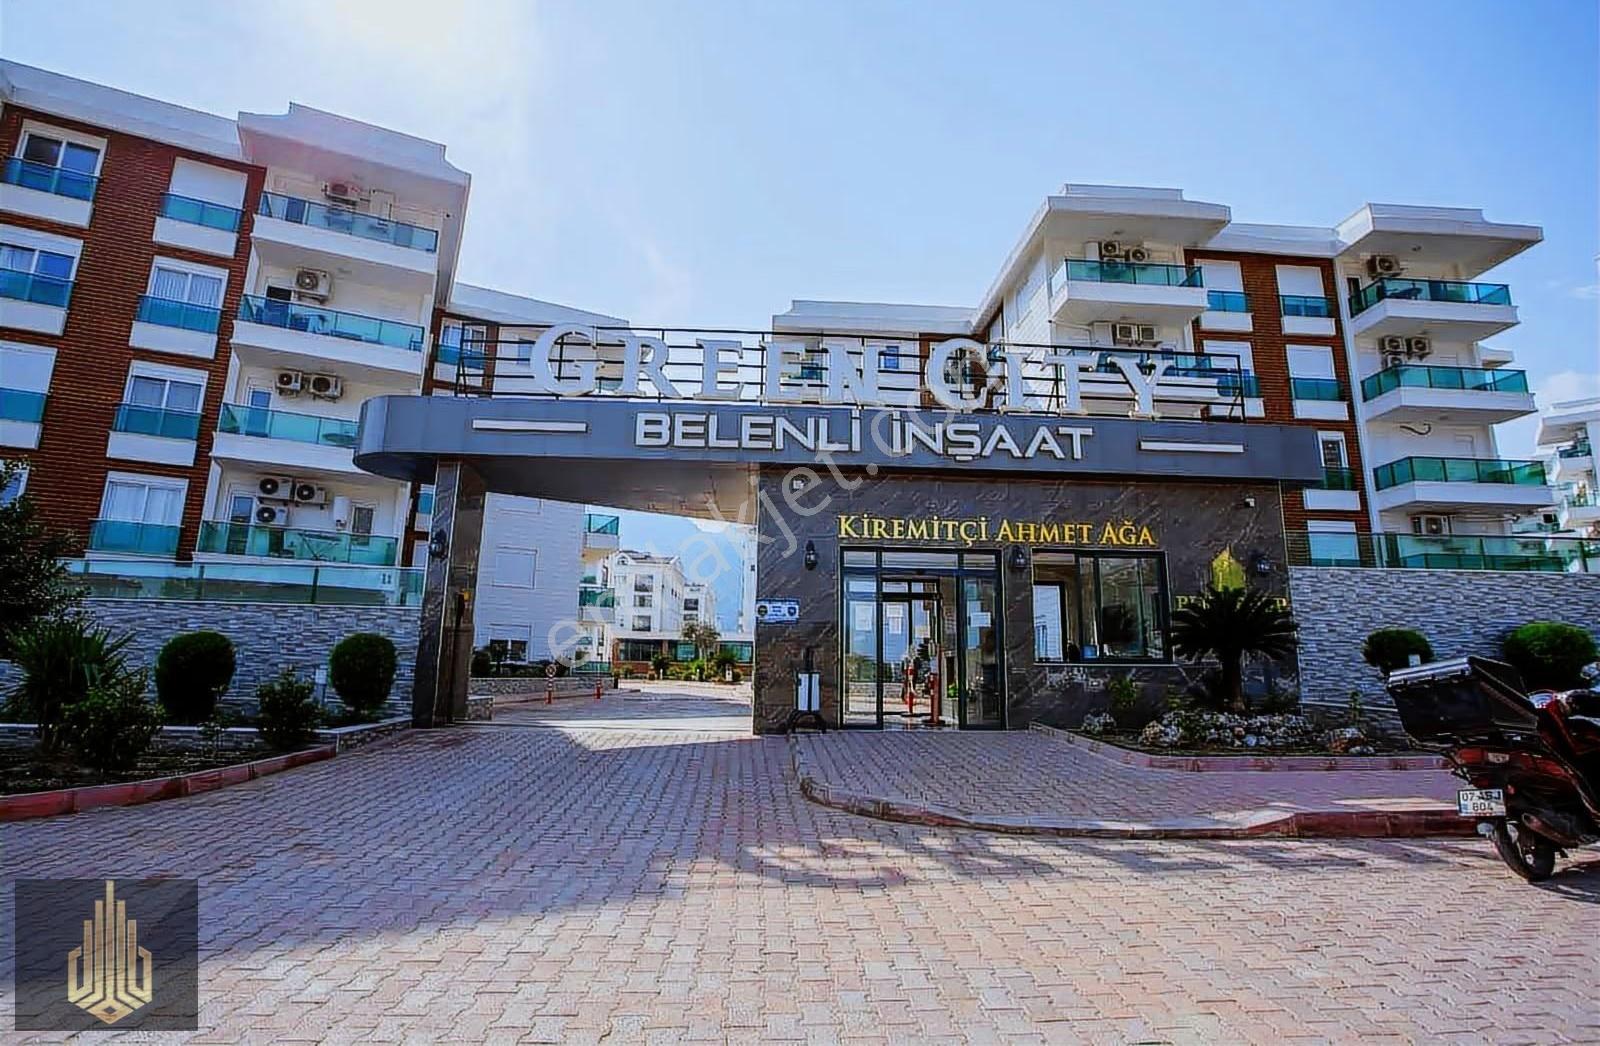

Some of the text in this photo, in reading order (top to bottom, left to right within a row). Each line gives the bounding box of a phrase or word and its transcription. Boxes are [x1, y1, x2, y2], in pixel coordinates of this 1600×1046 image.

[530, 323, 1168, 418] GREEN CITY
[635, 409, 1093, 461] BELENLİ İNŞAAT
[838, 514, 1156, 547] KİREMİTÇİ AHMET AĞA
